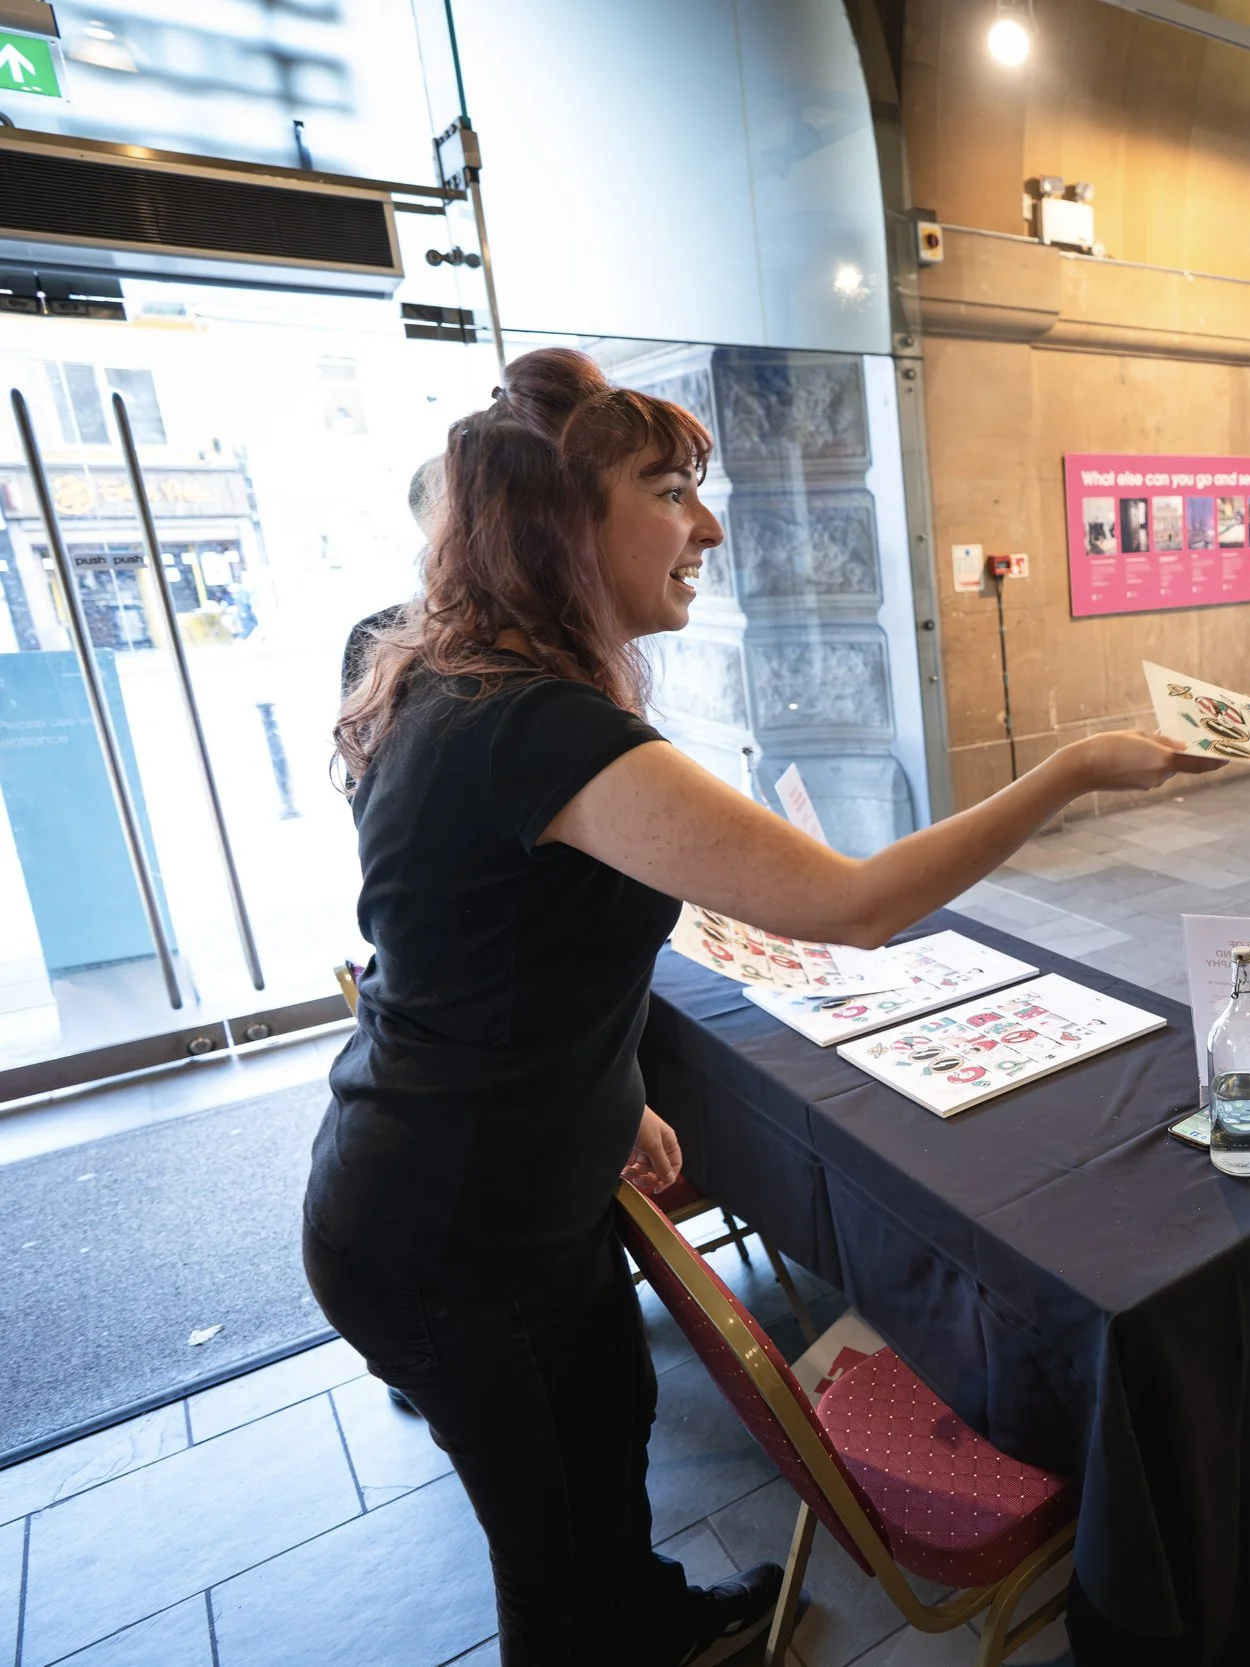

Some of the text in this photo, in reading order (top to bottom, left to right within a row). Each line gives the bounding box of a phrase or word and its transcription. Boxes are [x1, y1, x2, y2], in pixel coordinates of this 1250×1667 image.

[1081, 470, 1115, 486] What
[1117, 471, 1143, 486] else
[1145, 473, 1170, 486] can
[1171, 473, 1194, 489] you
[1196, 473, 1213, 489] go
[1214, 471, 1237, 486] and
[75, 555, 107, 567] push
[113, 554, 144, 566] push
